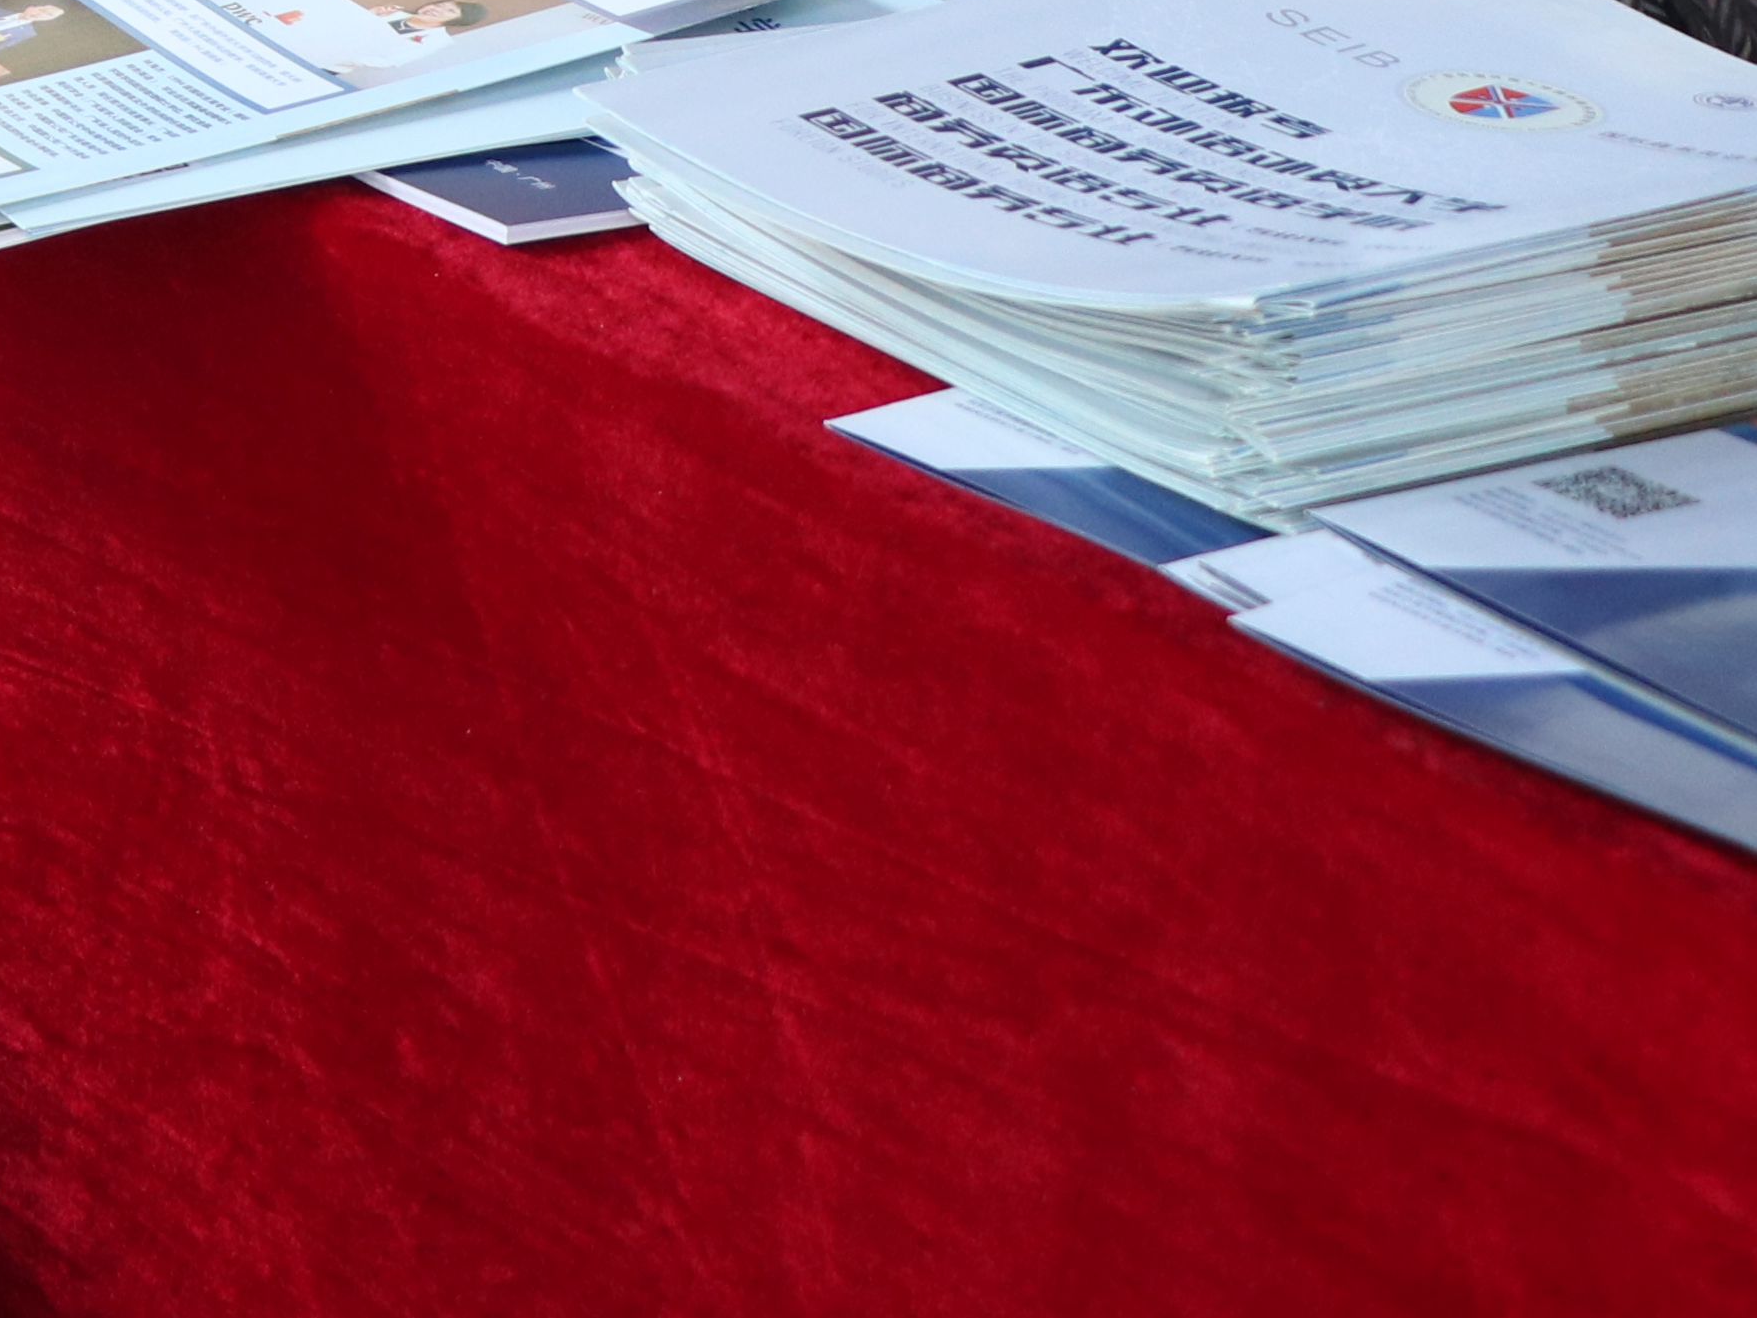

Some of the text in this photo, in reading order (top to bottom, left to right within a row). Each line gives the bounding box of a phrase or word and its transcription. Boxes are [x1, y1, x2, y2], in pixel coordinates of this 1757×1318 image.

[1089, 37, 1332, 139] 欢迎报考
[1265, 8, 1401, 69] SEIB
[799, 107, 1156, 245] 国际商务专业
[873, 91, 1233, 227] 商务英语专业
[947, 73, 1434, 231] 国际商务英语学院
[1018, 56, 1508, 212] 广东外语外贸大学
